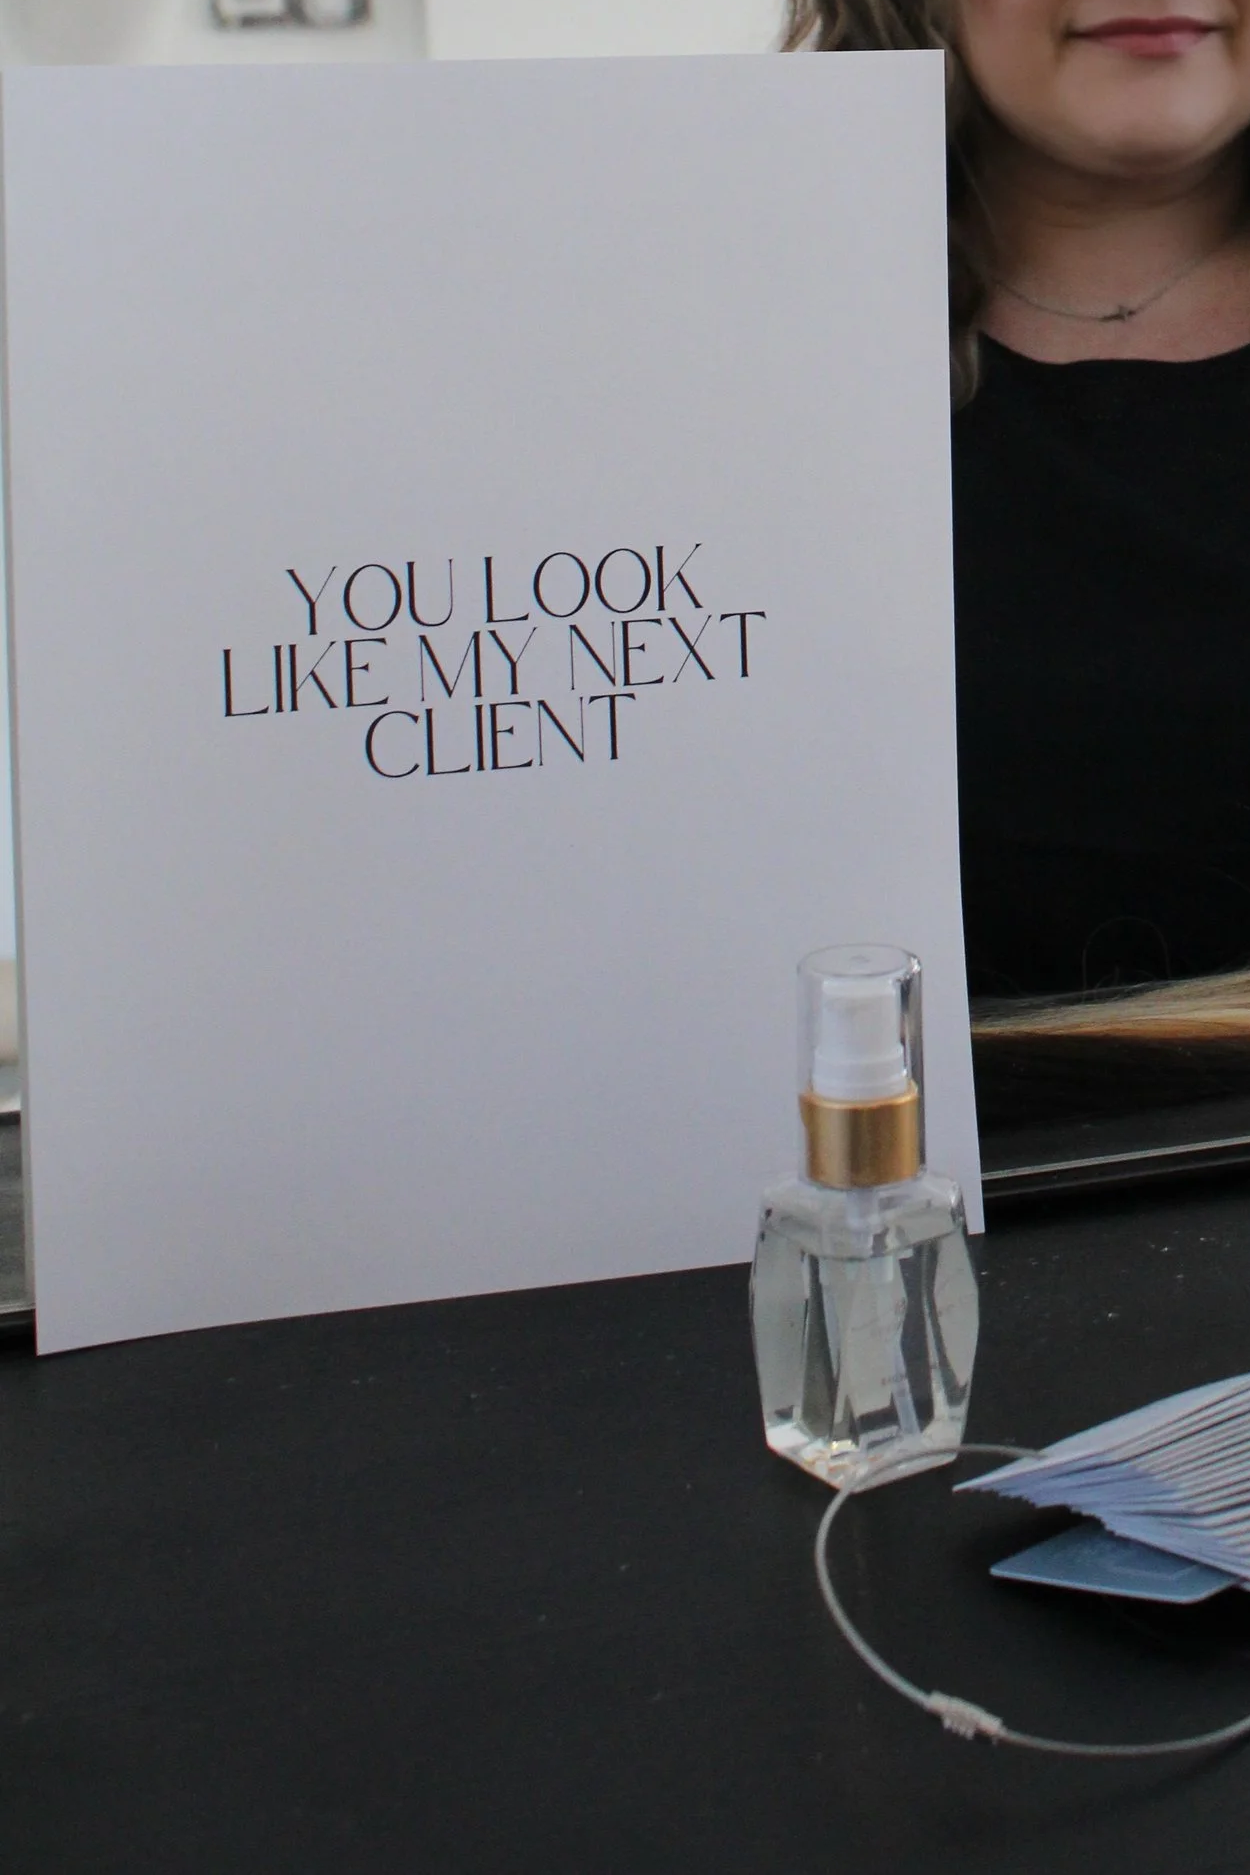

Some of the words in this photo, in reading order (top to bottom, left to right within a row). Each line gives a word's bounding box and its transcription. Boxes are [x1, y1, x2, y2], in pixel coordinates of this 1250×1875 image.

[285, 558, 455, 636] YOU
[484, 542, 704, 625] LOOK
[222, 637, 389, 718] LIKE
[418, 626, 538, 702] MY
[568, 611, 767, 692] NEXT
[364, 692, 637, 779] CLIENT
